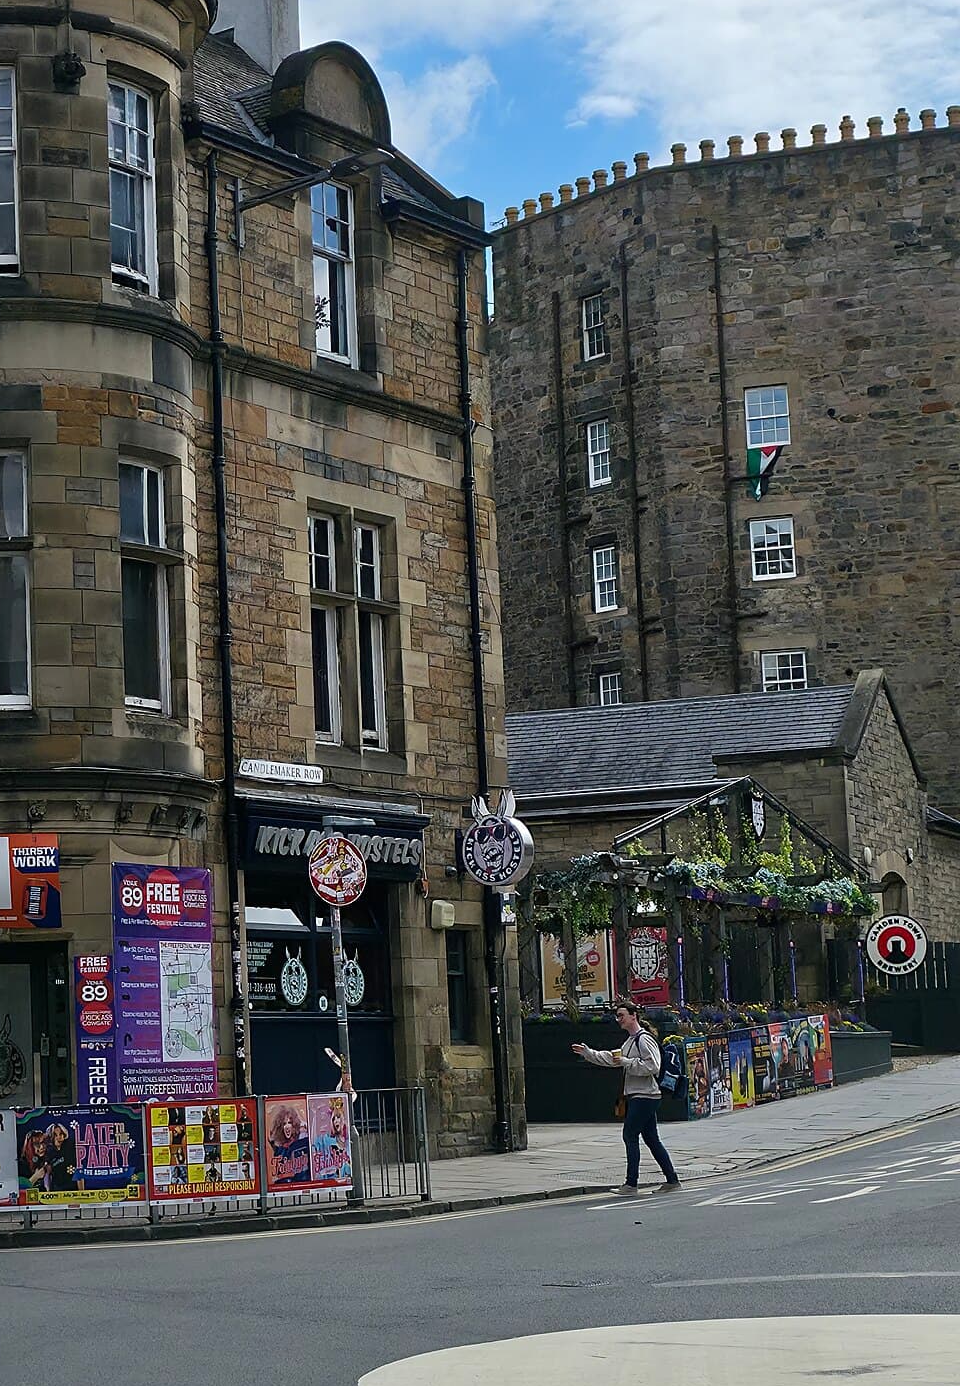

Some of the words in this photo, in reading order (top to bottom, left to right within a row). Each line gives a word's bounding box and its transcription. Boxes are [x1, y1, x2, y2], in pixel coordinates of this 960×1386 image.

[241, 761, 301, 779] CANDLEMAKER
[304, 769, 322, 781] ROW
[256, 826, 305, 856] KICK
[12, 846, 55, 856] THIRSTY
[466, 837, 476, 869] KICK
[475, 869, 496, 882] ASS
[499, 830, 520, 880] HOSTELS
[12, 855, 56, 868] WORK
[122, 886, 143, 907] 89
[146, 882, 180, 902] FREE
[146, 903, 181, 915] FESTIVAL
[870, 918, 900, 942] CAMDEN
[903, 919, 922, 940] TOWN
[632, 945, 657, 959] KICK
[80, 956, 107, 967] FREE
[877, 958, 918, 973] BREWERY
[80, 966, 108, 974] FESTIVAL
[81, 985, 108, 1002] 89
[85, 1014, 99, 1022] KICK
[100, 1013, 113, 1021] ASS
[88, 1057, 108, 1095] FREE
[123, 1082, 214, 1096] WWW.FREEFESTIVAL.CO.UK
[74, 1122, 115, 1146] LATE
[75, 1144, 130, 1169] PARTY
[169, 1184, 192, 1195] PLEASE
[193, 1182, 214, 1193] LAUGH
[214, 1180, 256, 1192] RESPONSIBLY
